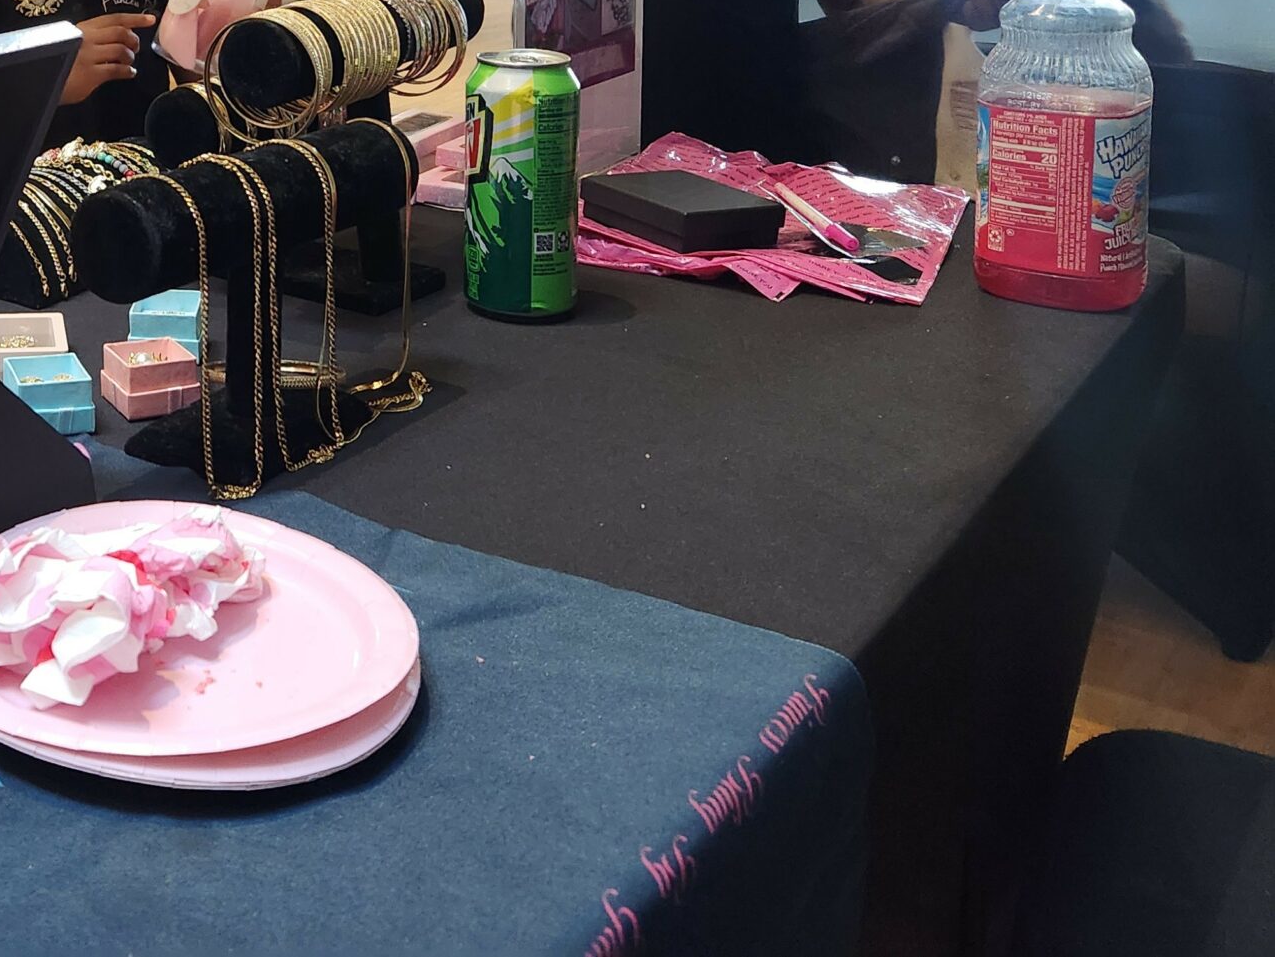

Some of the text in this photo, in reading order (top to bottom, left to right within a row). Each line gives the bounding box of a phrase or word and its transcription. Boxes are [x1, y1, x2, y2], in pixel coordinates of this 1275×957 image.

[992, 119, 1059, 136] Nutrition Facts
[992, 148, 1058, 165] Calories 20
